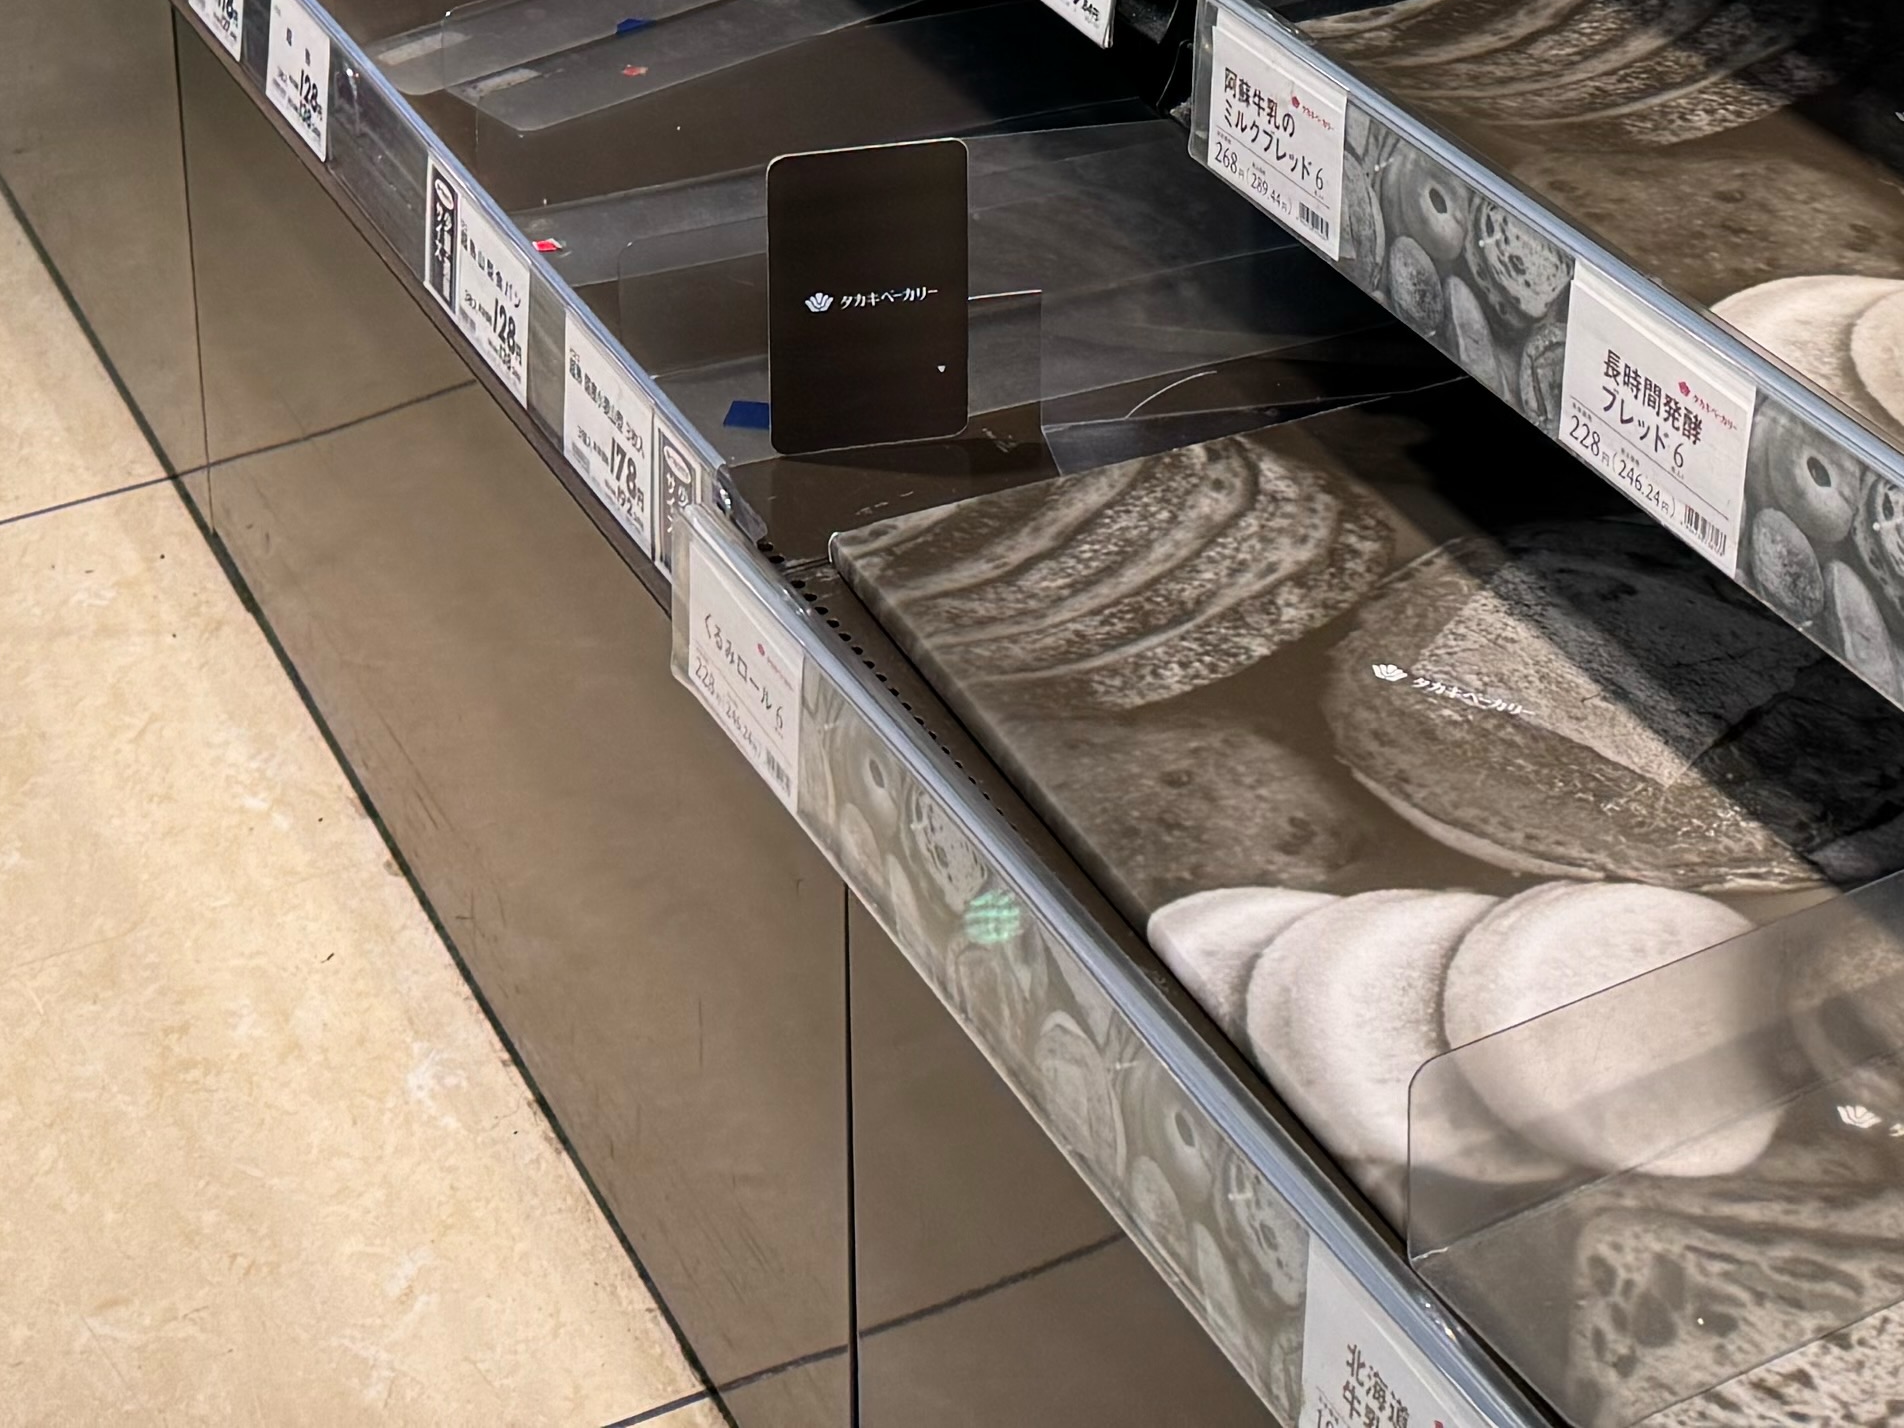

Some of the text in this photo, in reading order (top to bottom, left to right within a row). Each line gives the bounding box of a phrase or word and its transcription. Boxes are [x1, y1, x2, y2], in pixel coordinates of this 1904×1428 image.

[1224, 67, 1295, 138] 阿蘇牛乳の
[1214, 141, 1293, 215] 268円 (289.44円)
[1223, 99, 1324, 192] ミルクブレッド 6
[493, 298, 522, 366] 128円
[839, 287, 939, 309] タカキベーカリー
[1602, 385, 1685, 470] ブレッド 6
[1603, 349, 1703, 445] 長時間発酵
[609, 437, 645, 514] 178円
[1569, 415, 1676, 518] 228円 (246.24円)
[704, 613, 772, 710] くるみロール
[1412, 675, 1536, 719] タカキベーカリー
